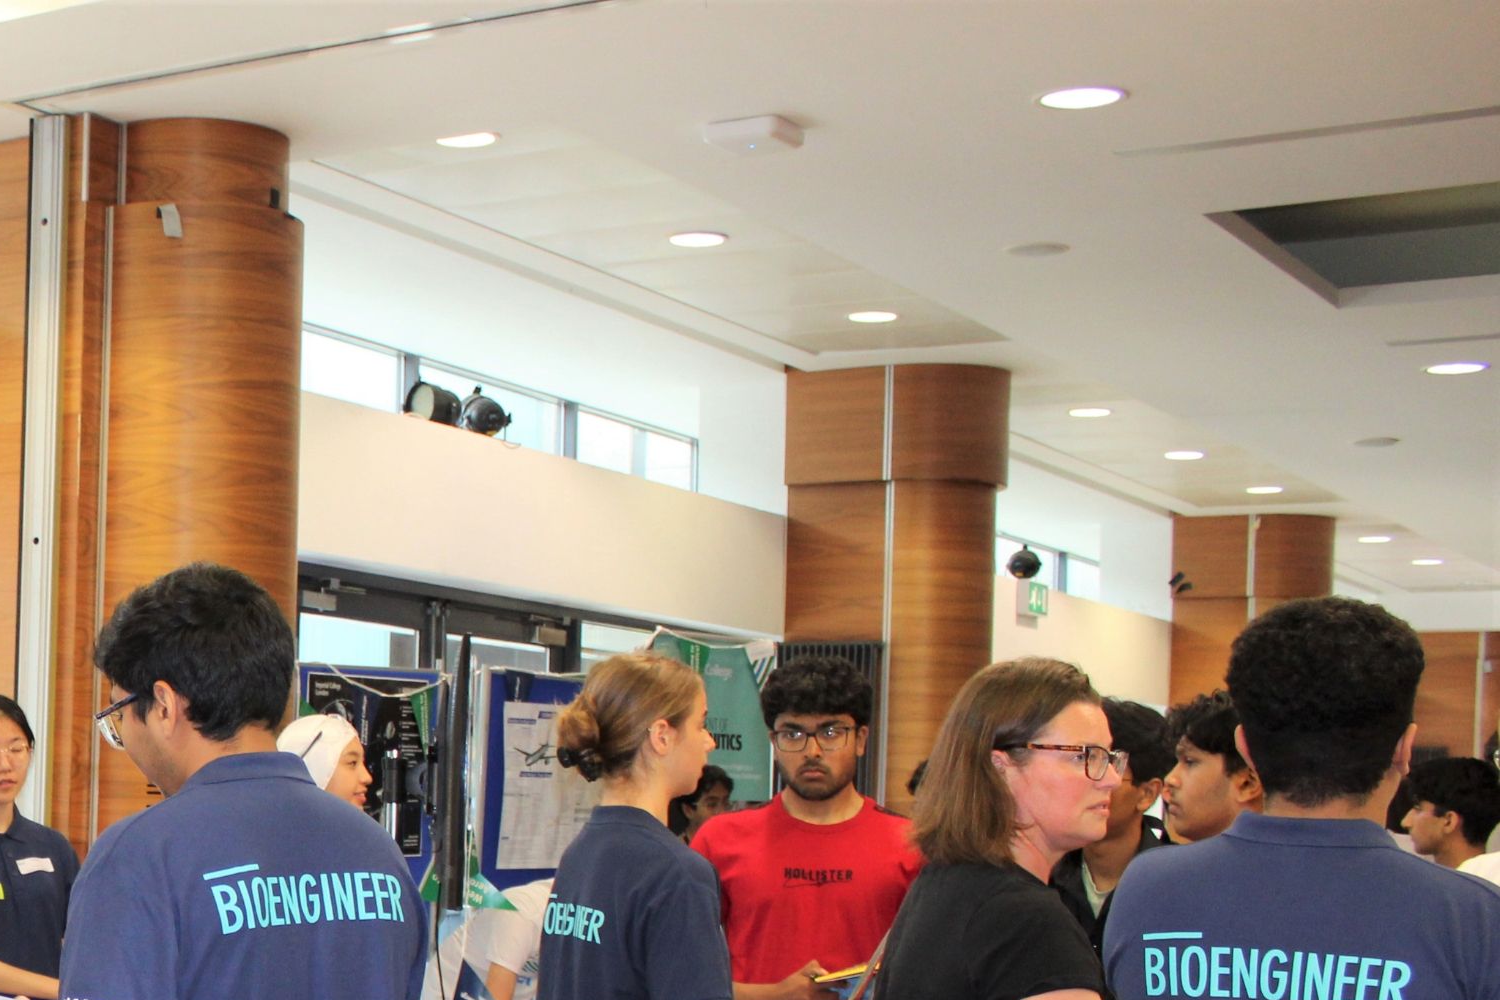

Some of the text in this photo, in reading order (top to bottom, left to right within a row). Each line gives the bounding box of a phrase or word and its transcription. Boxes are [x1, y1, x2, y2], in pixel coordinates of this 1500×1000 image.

[714, 733, 743, 751] UTICS
[783, 867, 854, 884] HOLLISTER
[211, 872, 405, 935] BIOENGINEER
